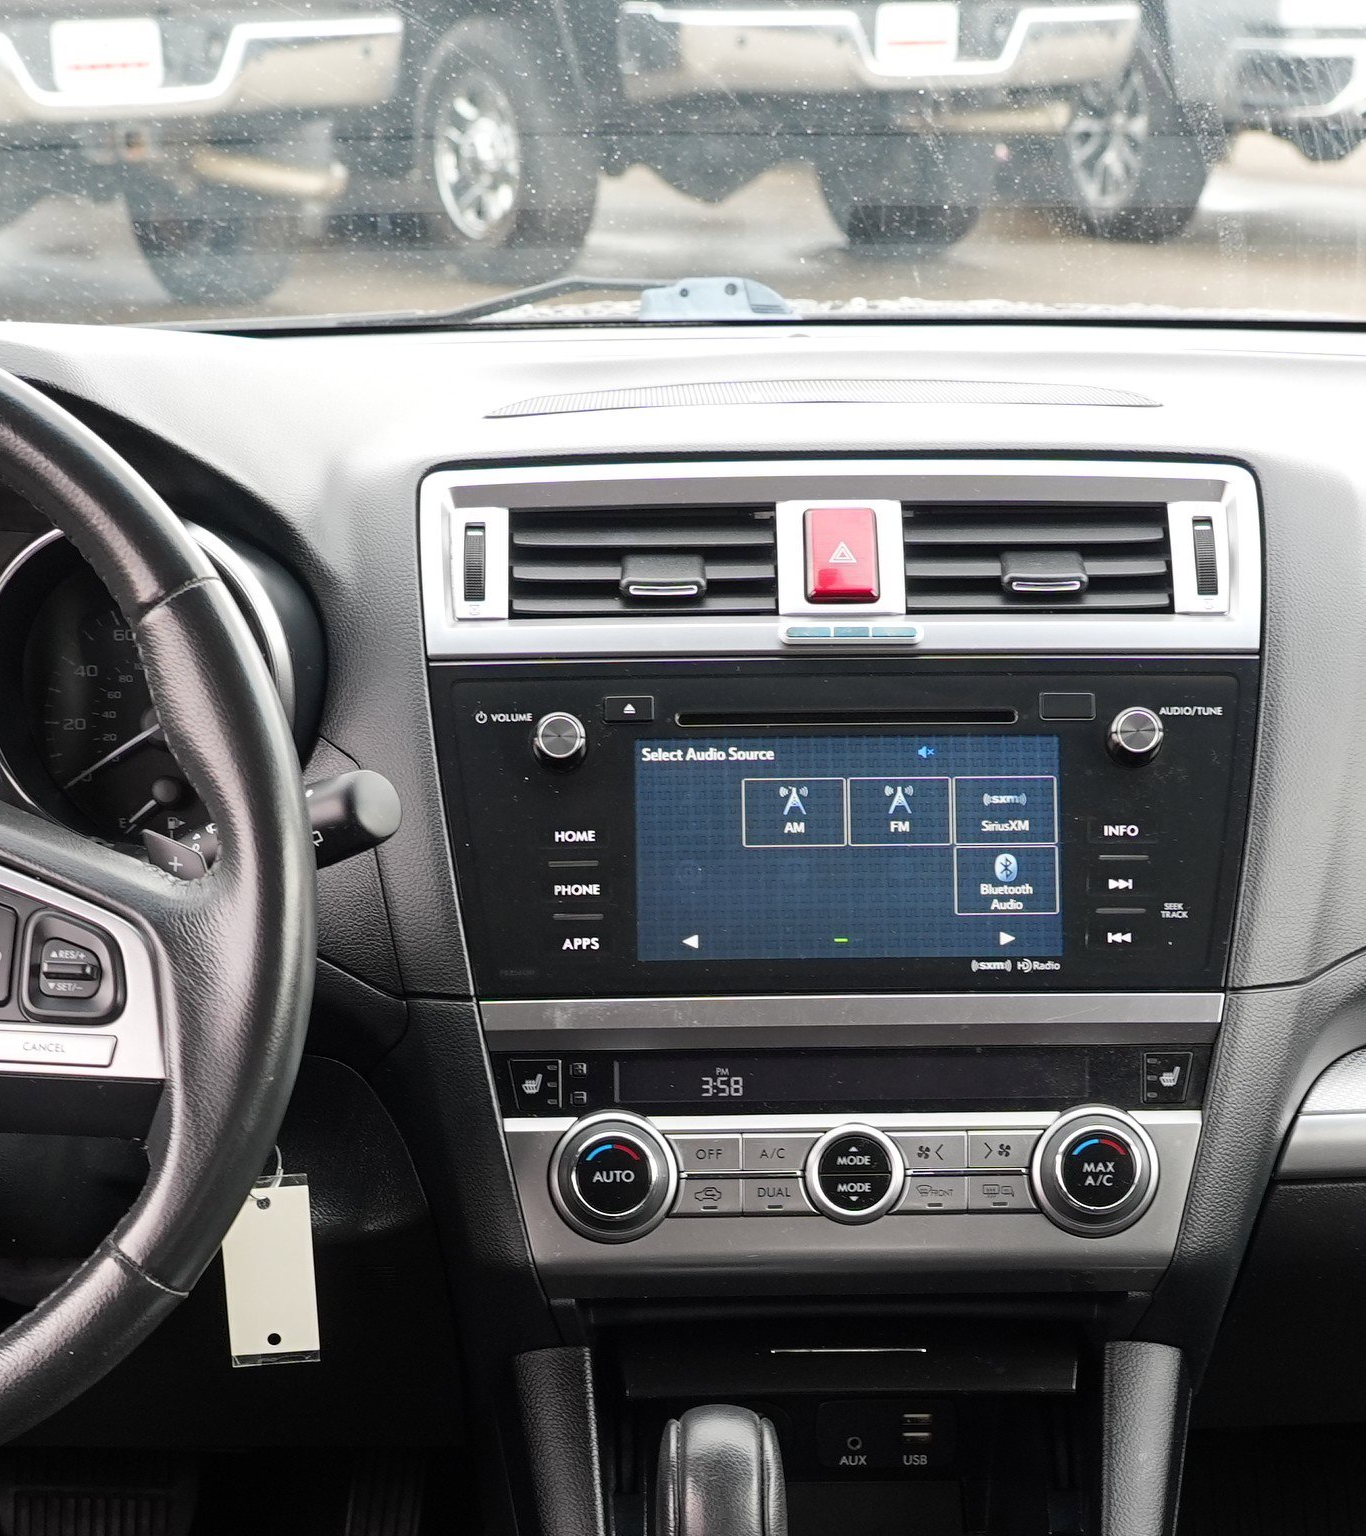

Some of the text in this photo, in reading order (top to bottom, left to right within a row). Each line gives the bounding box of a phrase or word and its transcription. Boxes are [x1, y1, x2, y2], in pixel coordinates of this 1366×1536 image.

[75, 665, 98, 677] 40
[491, 712, 533, 723] VOLUME
[1159, 706, 1223, 717] AUDIO/TUNE
[63, 719, 86, 731] 20
[641, 747, 775, 762] Select Audio Source
[784, 822, 805, 834] AM
[890, 821, 910, 833] FM
[981, 819, 1030, 832] SiriusXM
[1103, 825, 1139, 837] INFO
[554, 830, 596, 842] HOME
[554, 884, 601, 896] PHONE
[980, 883, 1034, 895] Bluetooth
[990, 899, 1023, 911] Audio
[1163, 902, 1184, 911] SEEK
[1160, 911, 1189, 919] TRACK
[562, 938, 600, 950] APPS
[22, 1041, 66, 1053] CANCEL
[716, 1067, 729, 1076] PM
[701, 1076, 744, 1097] 3:58
[695, 1149, 723, 1161] OFF
[760, 1148, 786, 1160] A/C
[836, 1155, 871, 1166] MODE
[1082, 1161, 1115, 1173] MAX
[592, 1169, 635, 1183] AUTO
[1084, 1174, 1114, 1187] A/C
[758, 1186, 791, 1198] DUAL
[836, 1182, 872, 1193] MODE
[839, 1455, 867, 1466] AUX
[903, 1455, 928, 1466] USB
